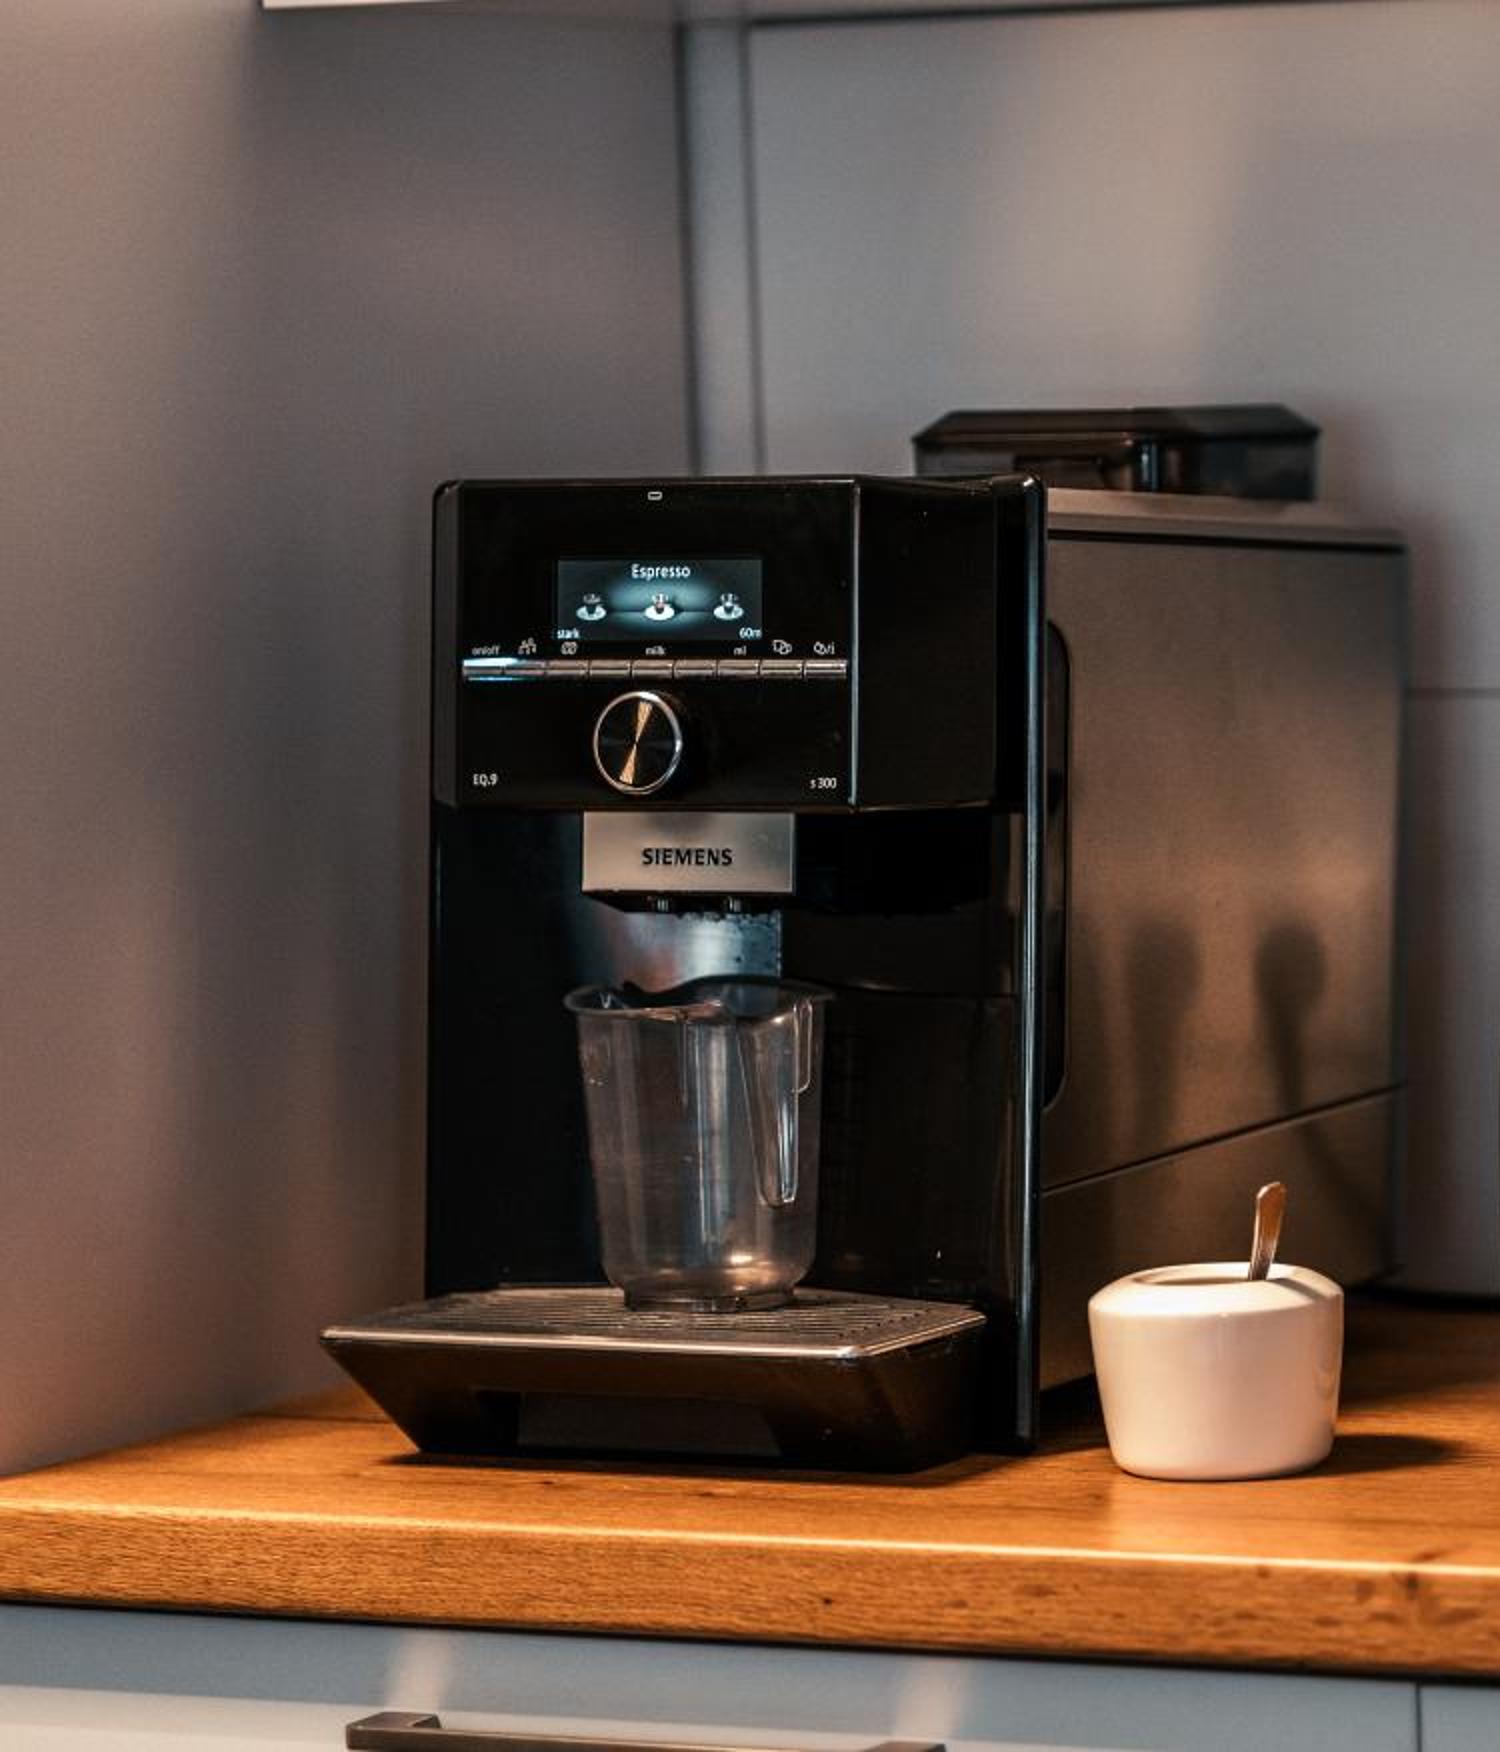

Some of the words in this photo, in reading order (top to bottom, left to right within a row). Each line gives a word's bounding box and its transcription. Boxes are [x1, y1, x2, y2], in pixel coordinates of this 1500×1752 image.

[631, 563, 691, 580] Espresso
[557, 628, 580, 639] stark
[645, 645, 666, 656] milk
[473, 773, 498, 787] EQ.9
[817, 777, 837, 789] 300
[642, 847, 733, 866] SIEMENS
